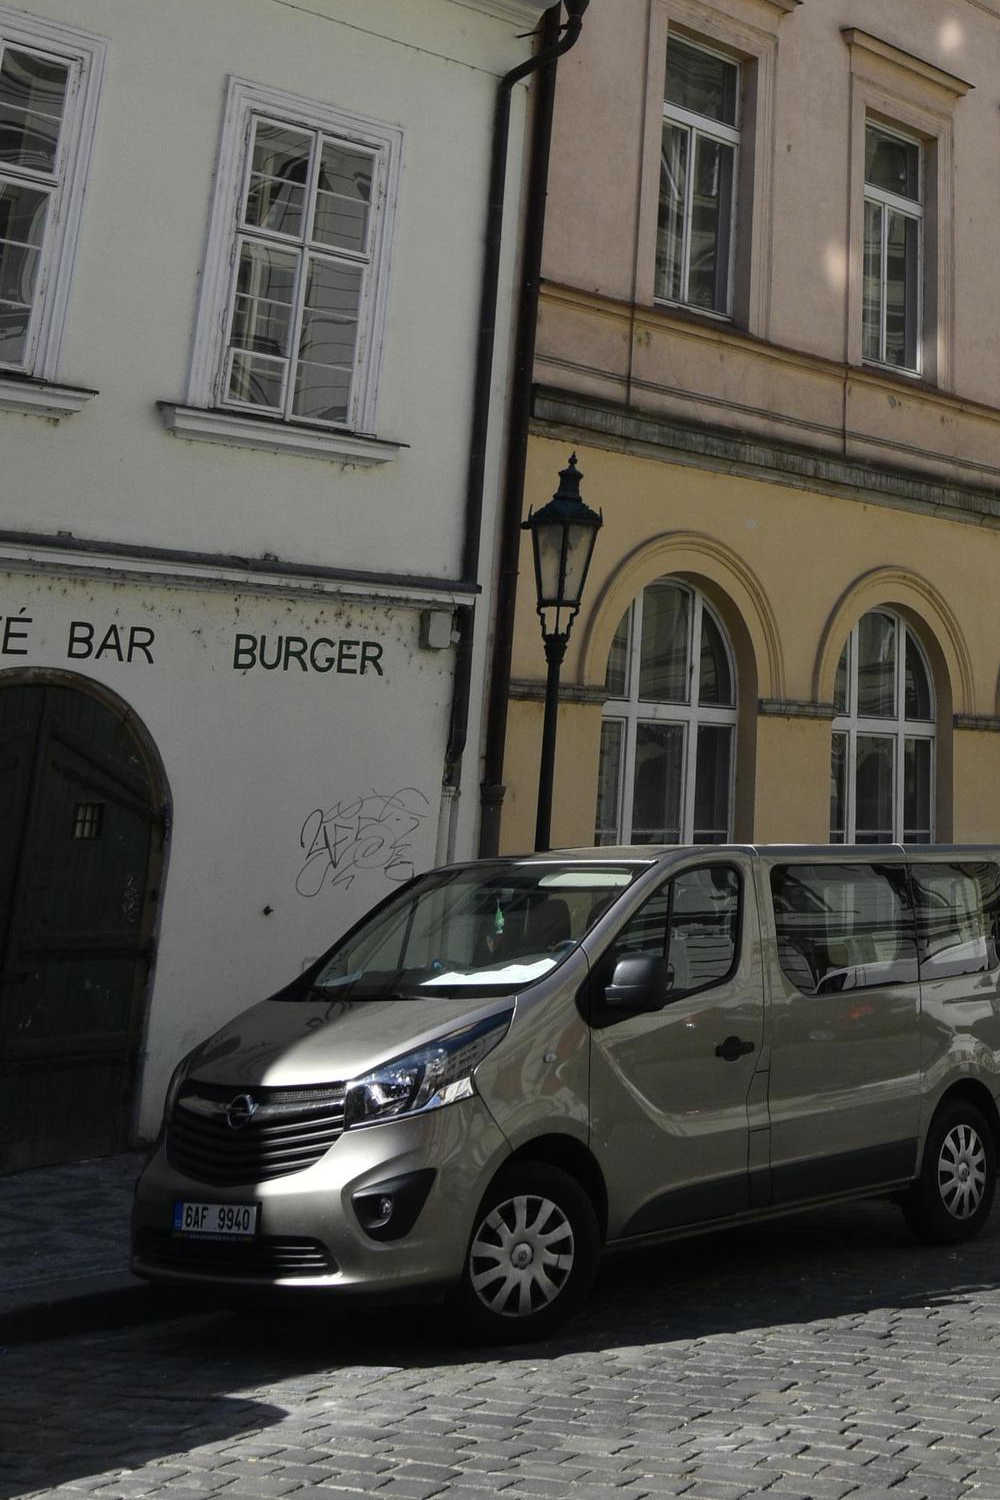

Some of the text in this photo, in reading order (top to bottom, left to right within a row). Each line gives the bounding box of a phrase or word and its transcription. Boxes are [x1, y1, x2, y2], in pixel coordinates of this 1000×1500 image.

[67, 621, 155, 665] BAR
[233, 634, 384, 676] BURGER
[185, 1205, 250, 1231] 6AF 9940
